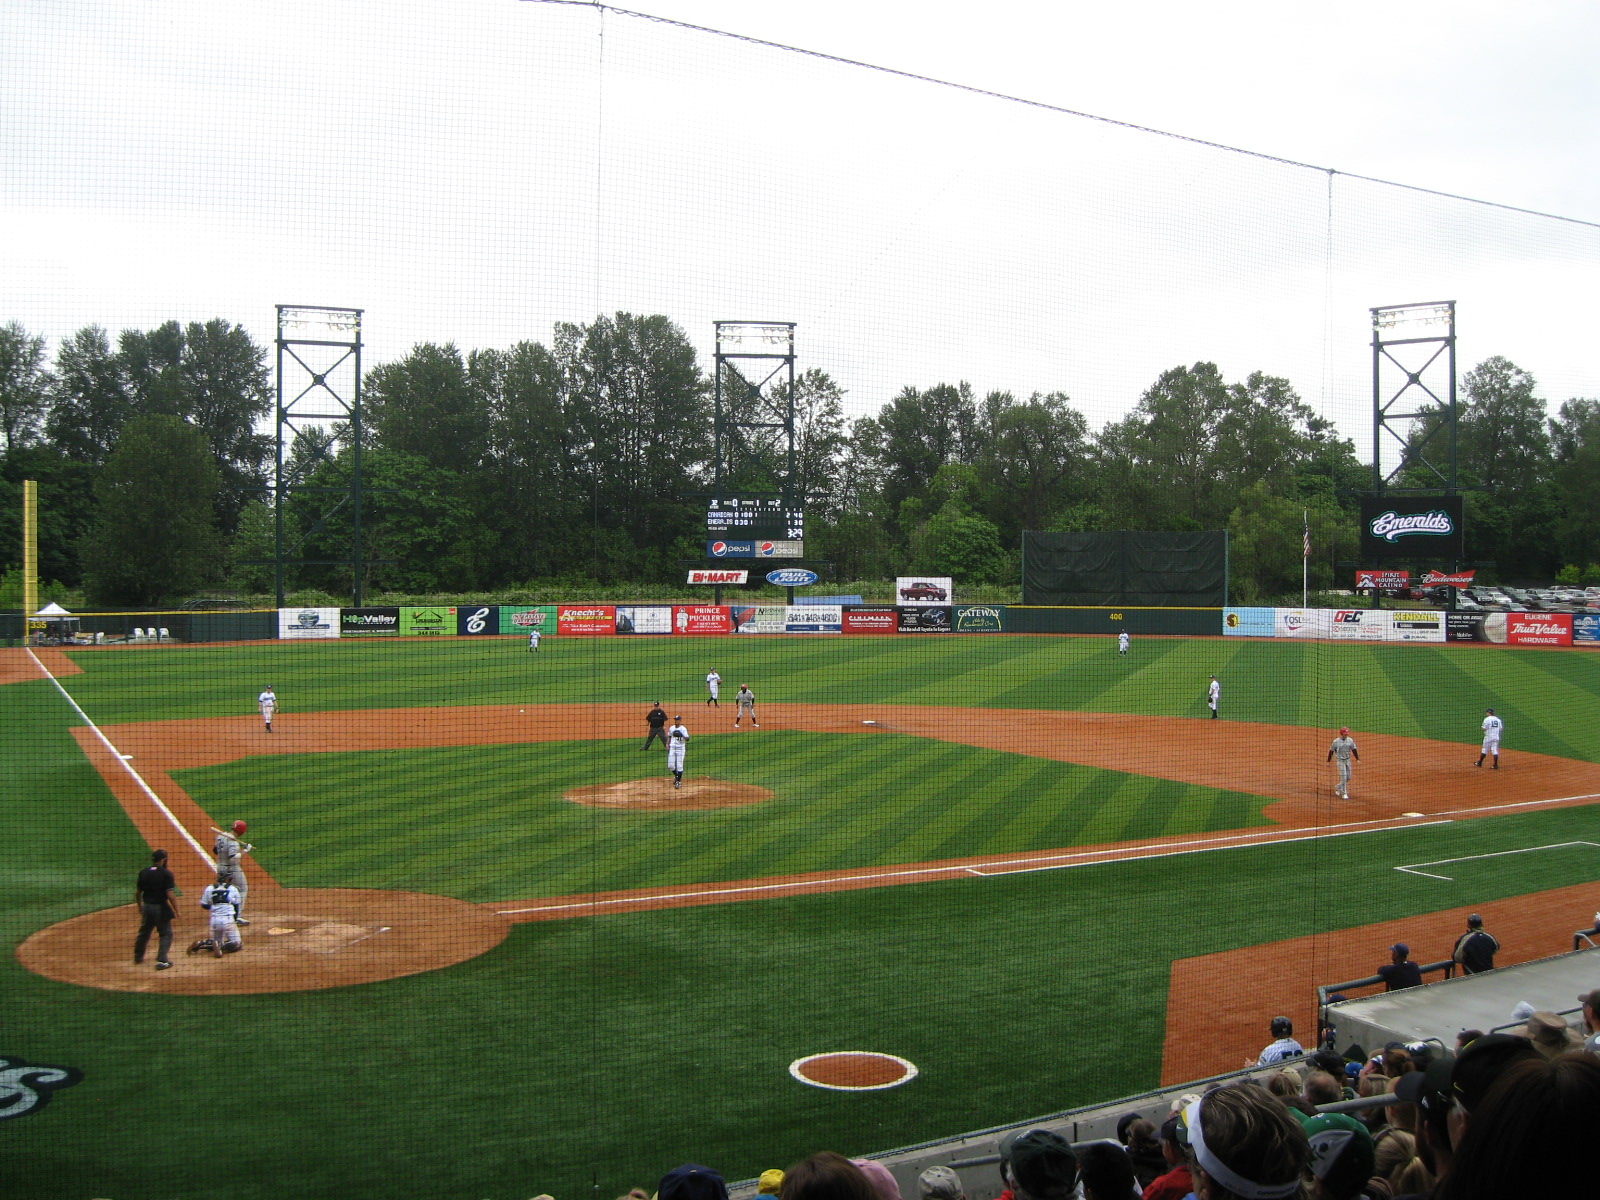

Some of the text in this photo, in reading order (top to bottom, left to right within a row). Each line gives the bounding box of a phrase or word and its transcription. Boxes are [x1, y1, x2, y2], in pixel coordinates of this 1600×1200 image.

[732, 499, 738, 507] 0
[1372, 512, 1452, 540] Emeralds
[787, 528, 803, 538] 3:29
[1421, 573, 1474, 584] Budweiser
[564, 609, 605, 617] Knecht's
[957, 609, 1001, 617] GATEWAY
[1110, 613, 1123, 621] 400
[1393, 612, 1439, 621] KENDALL
[690, 614, 727, 622] PUCKLER'S
